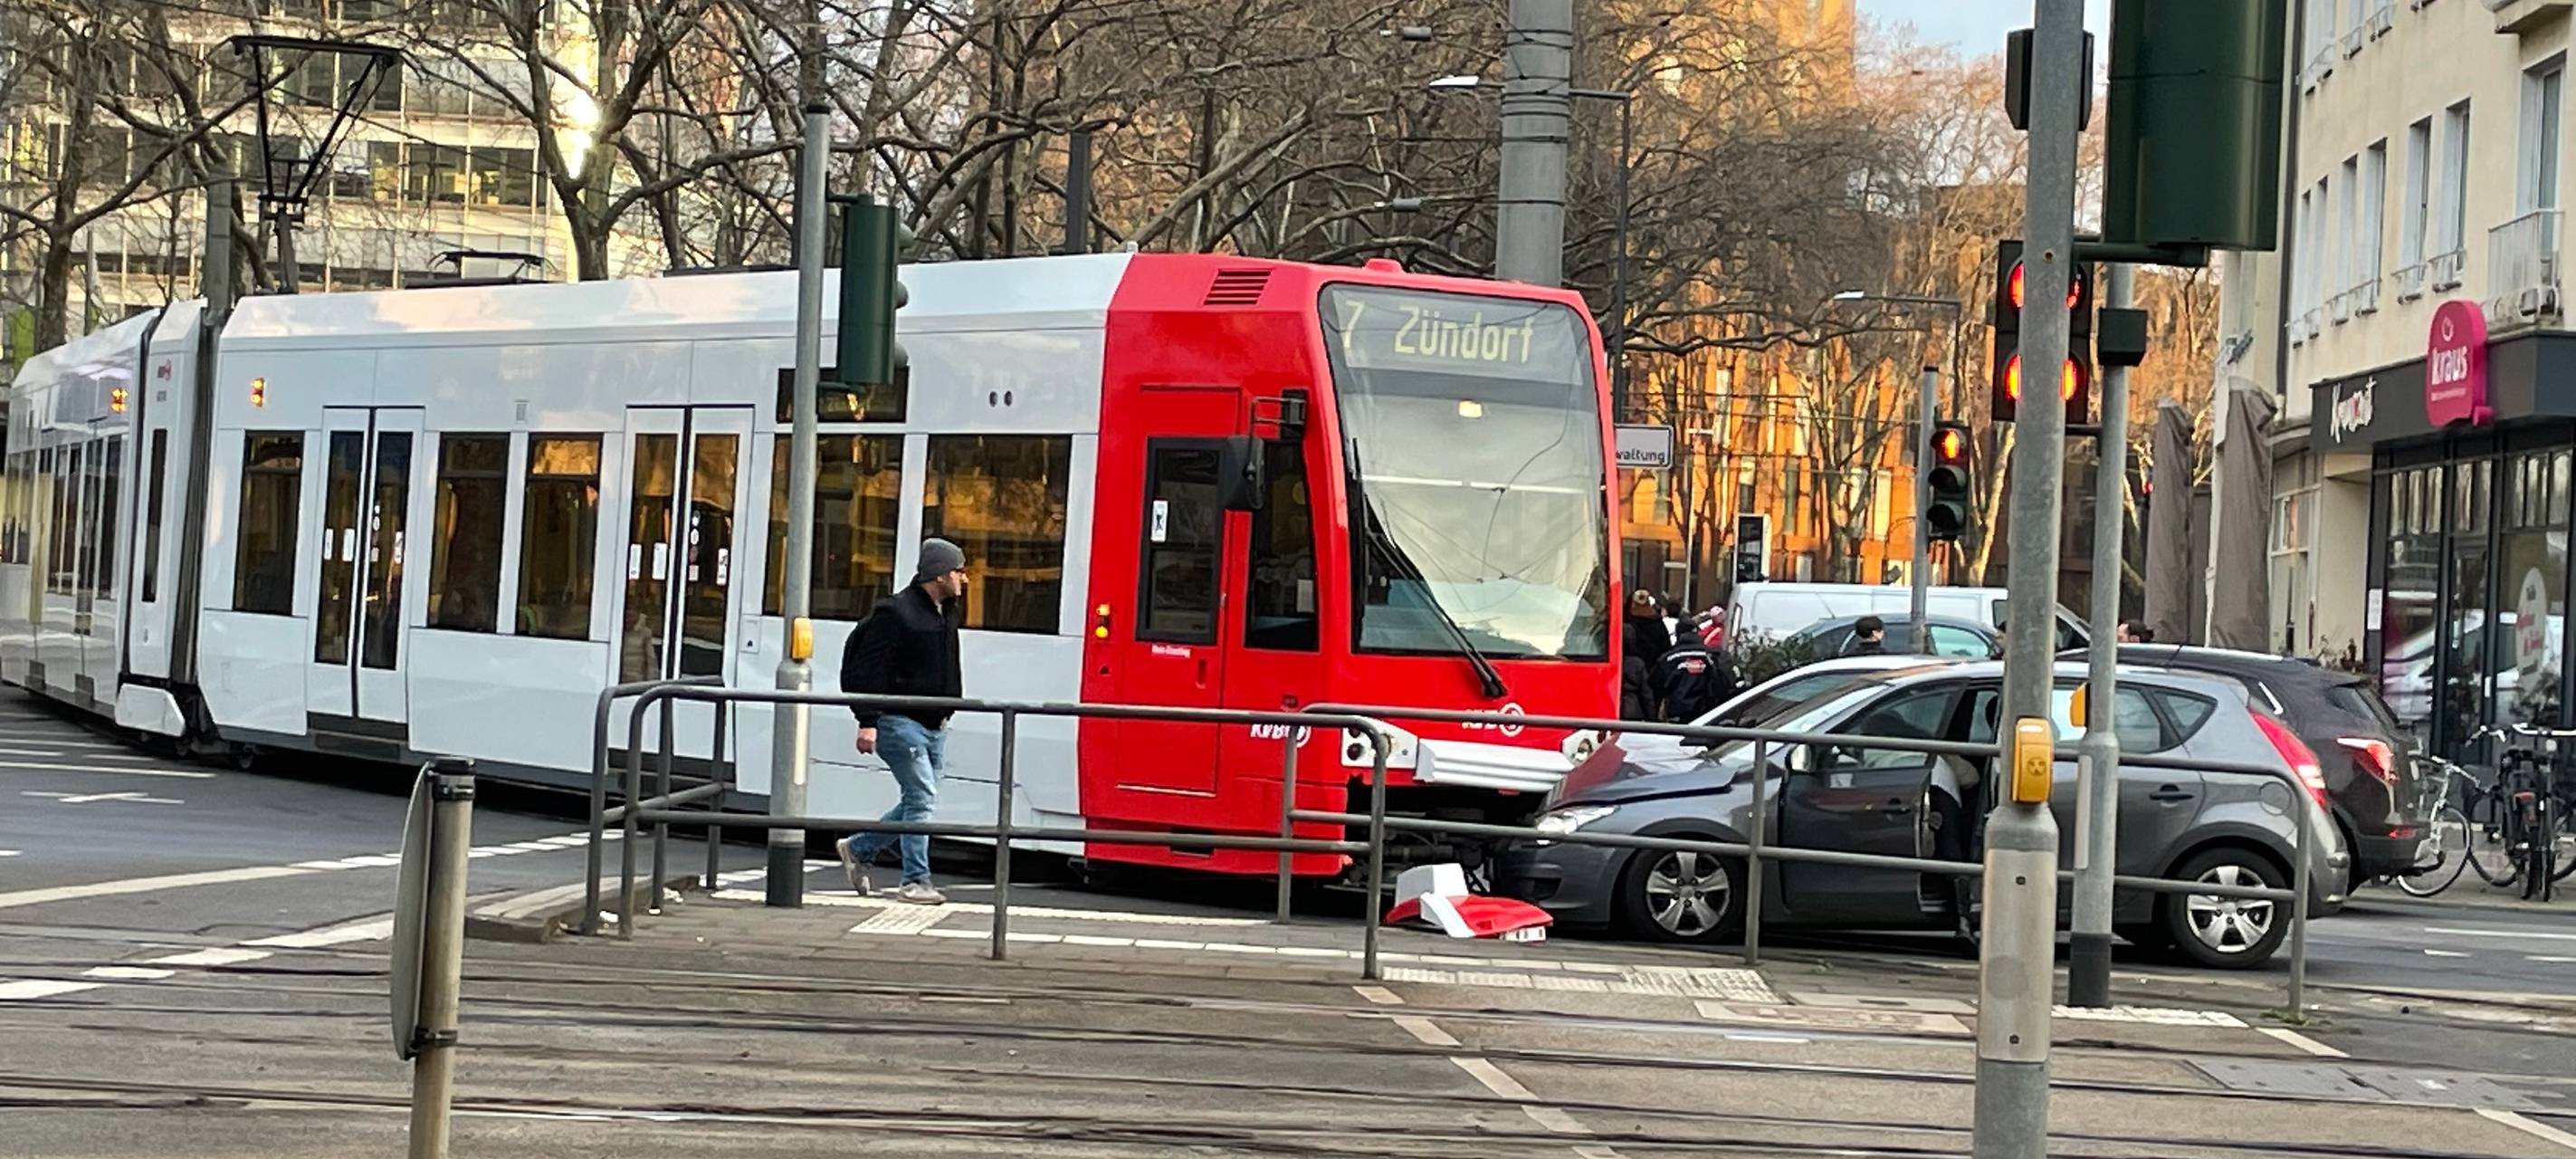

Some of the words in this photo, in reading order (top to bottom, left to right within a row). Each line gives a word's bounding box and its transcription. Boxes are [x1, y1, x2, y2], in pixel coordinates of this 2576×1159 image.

[1343, 300, 1365, 349] 7
[1395, 305, 1534, 363] Zündorf
[2431, 346, 2468, 386] kraus
